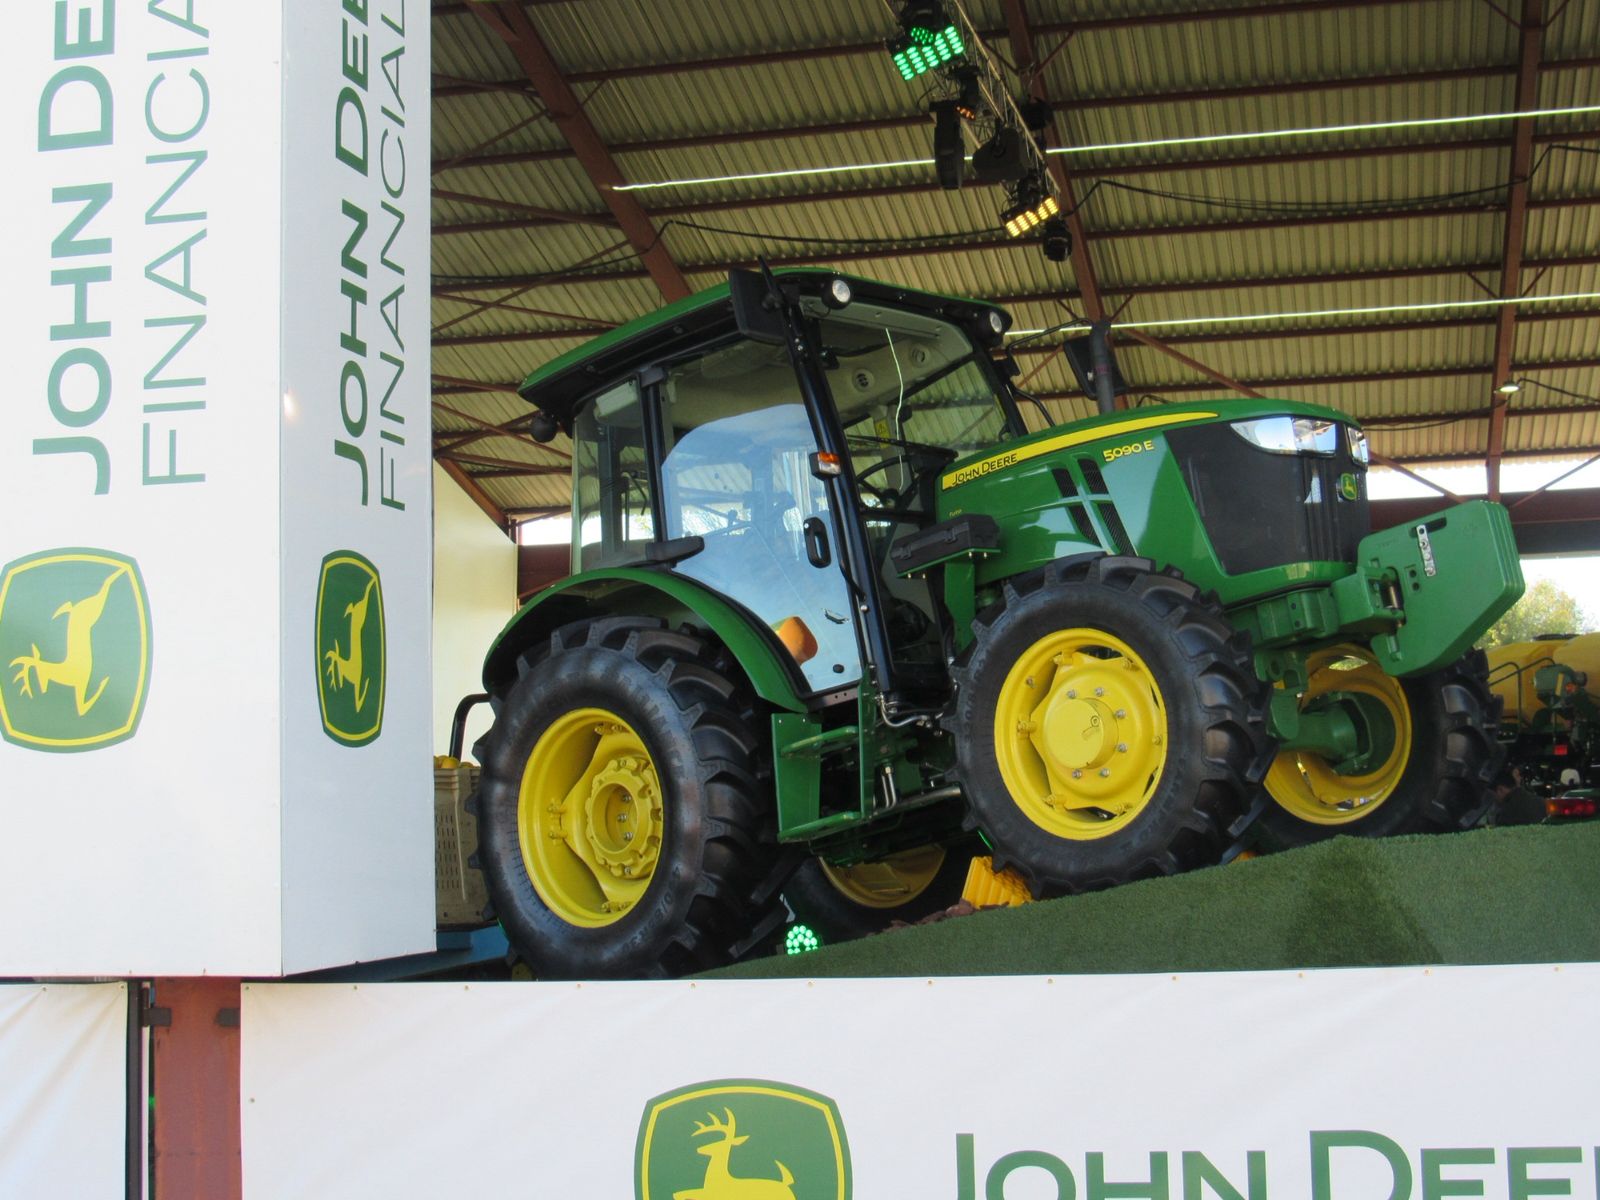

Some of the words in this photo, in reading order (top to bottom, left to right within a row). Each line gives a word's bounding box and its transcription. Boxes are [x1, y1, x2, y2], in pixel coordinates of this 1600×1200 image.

[33, 182, 113, 495] JOHN
[334, 198, 369, 506] JOHN
[952, 467, 980, 486] JOHN
[981, 453, 1018, 474] DEERE
[1103, 443, 1142, 462] 5090
[1309, 1130, 1600, 1200] DEE
